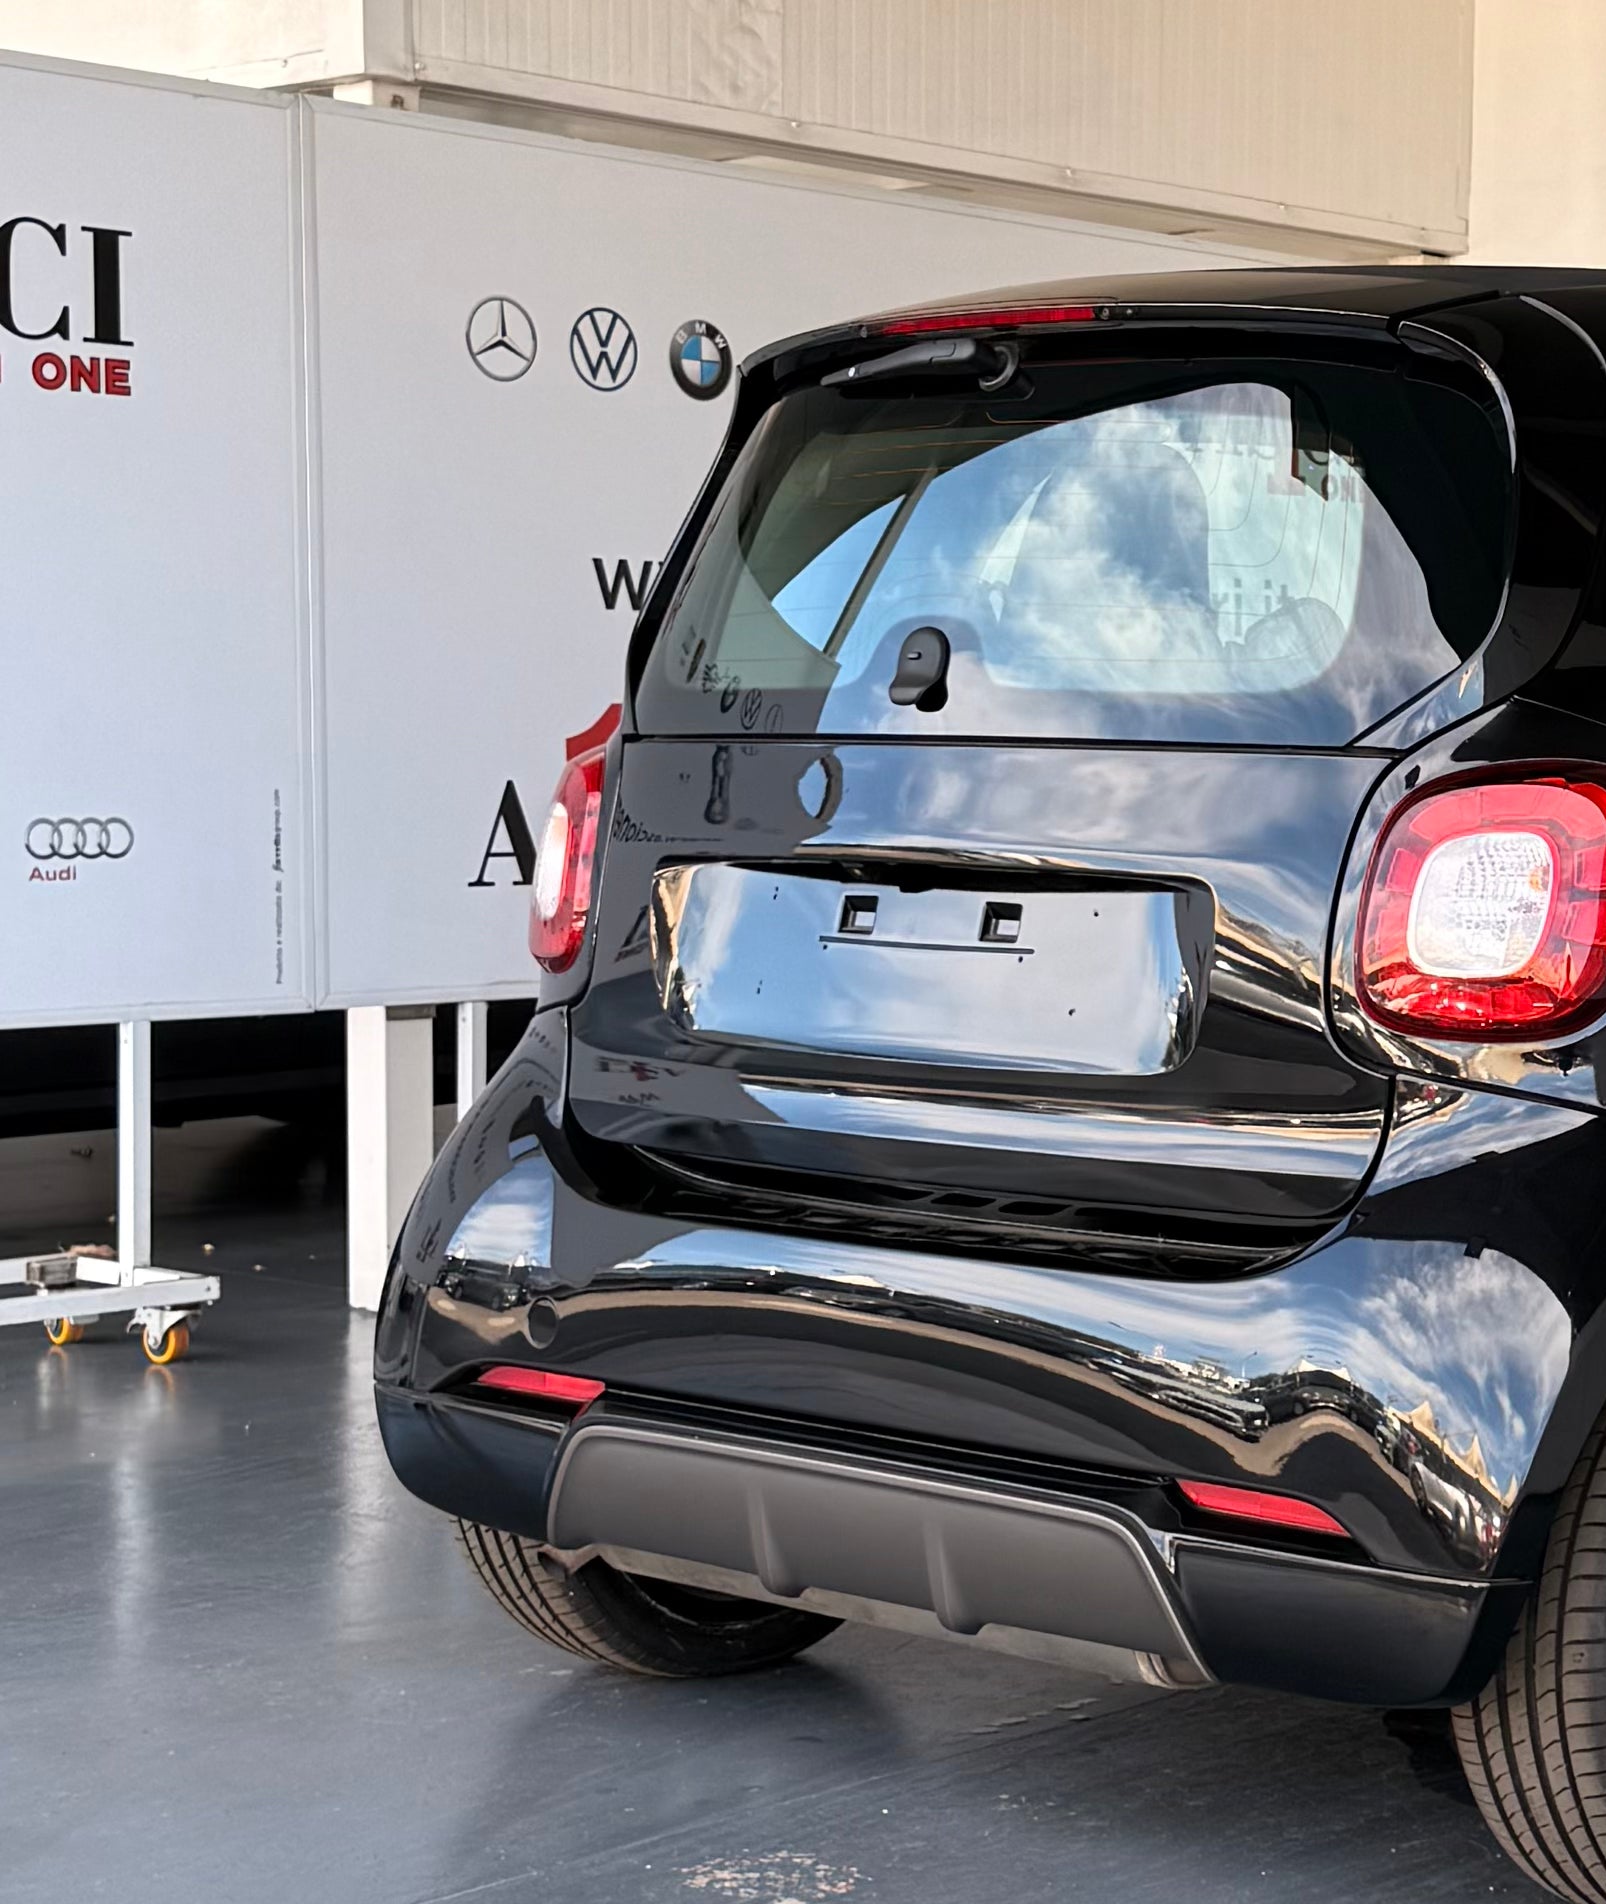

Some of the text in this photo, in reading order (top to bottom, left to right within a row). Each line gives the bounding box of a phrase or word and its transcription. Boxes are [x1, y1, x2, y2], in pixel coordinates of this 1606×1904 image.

[31, 352, 132, 397] ONE
[592, 557, 664, 611] W
[29, 864, 77, 881] Audi
